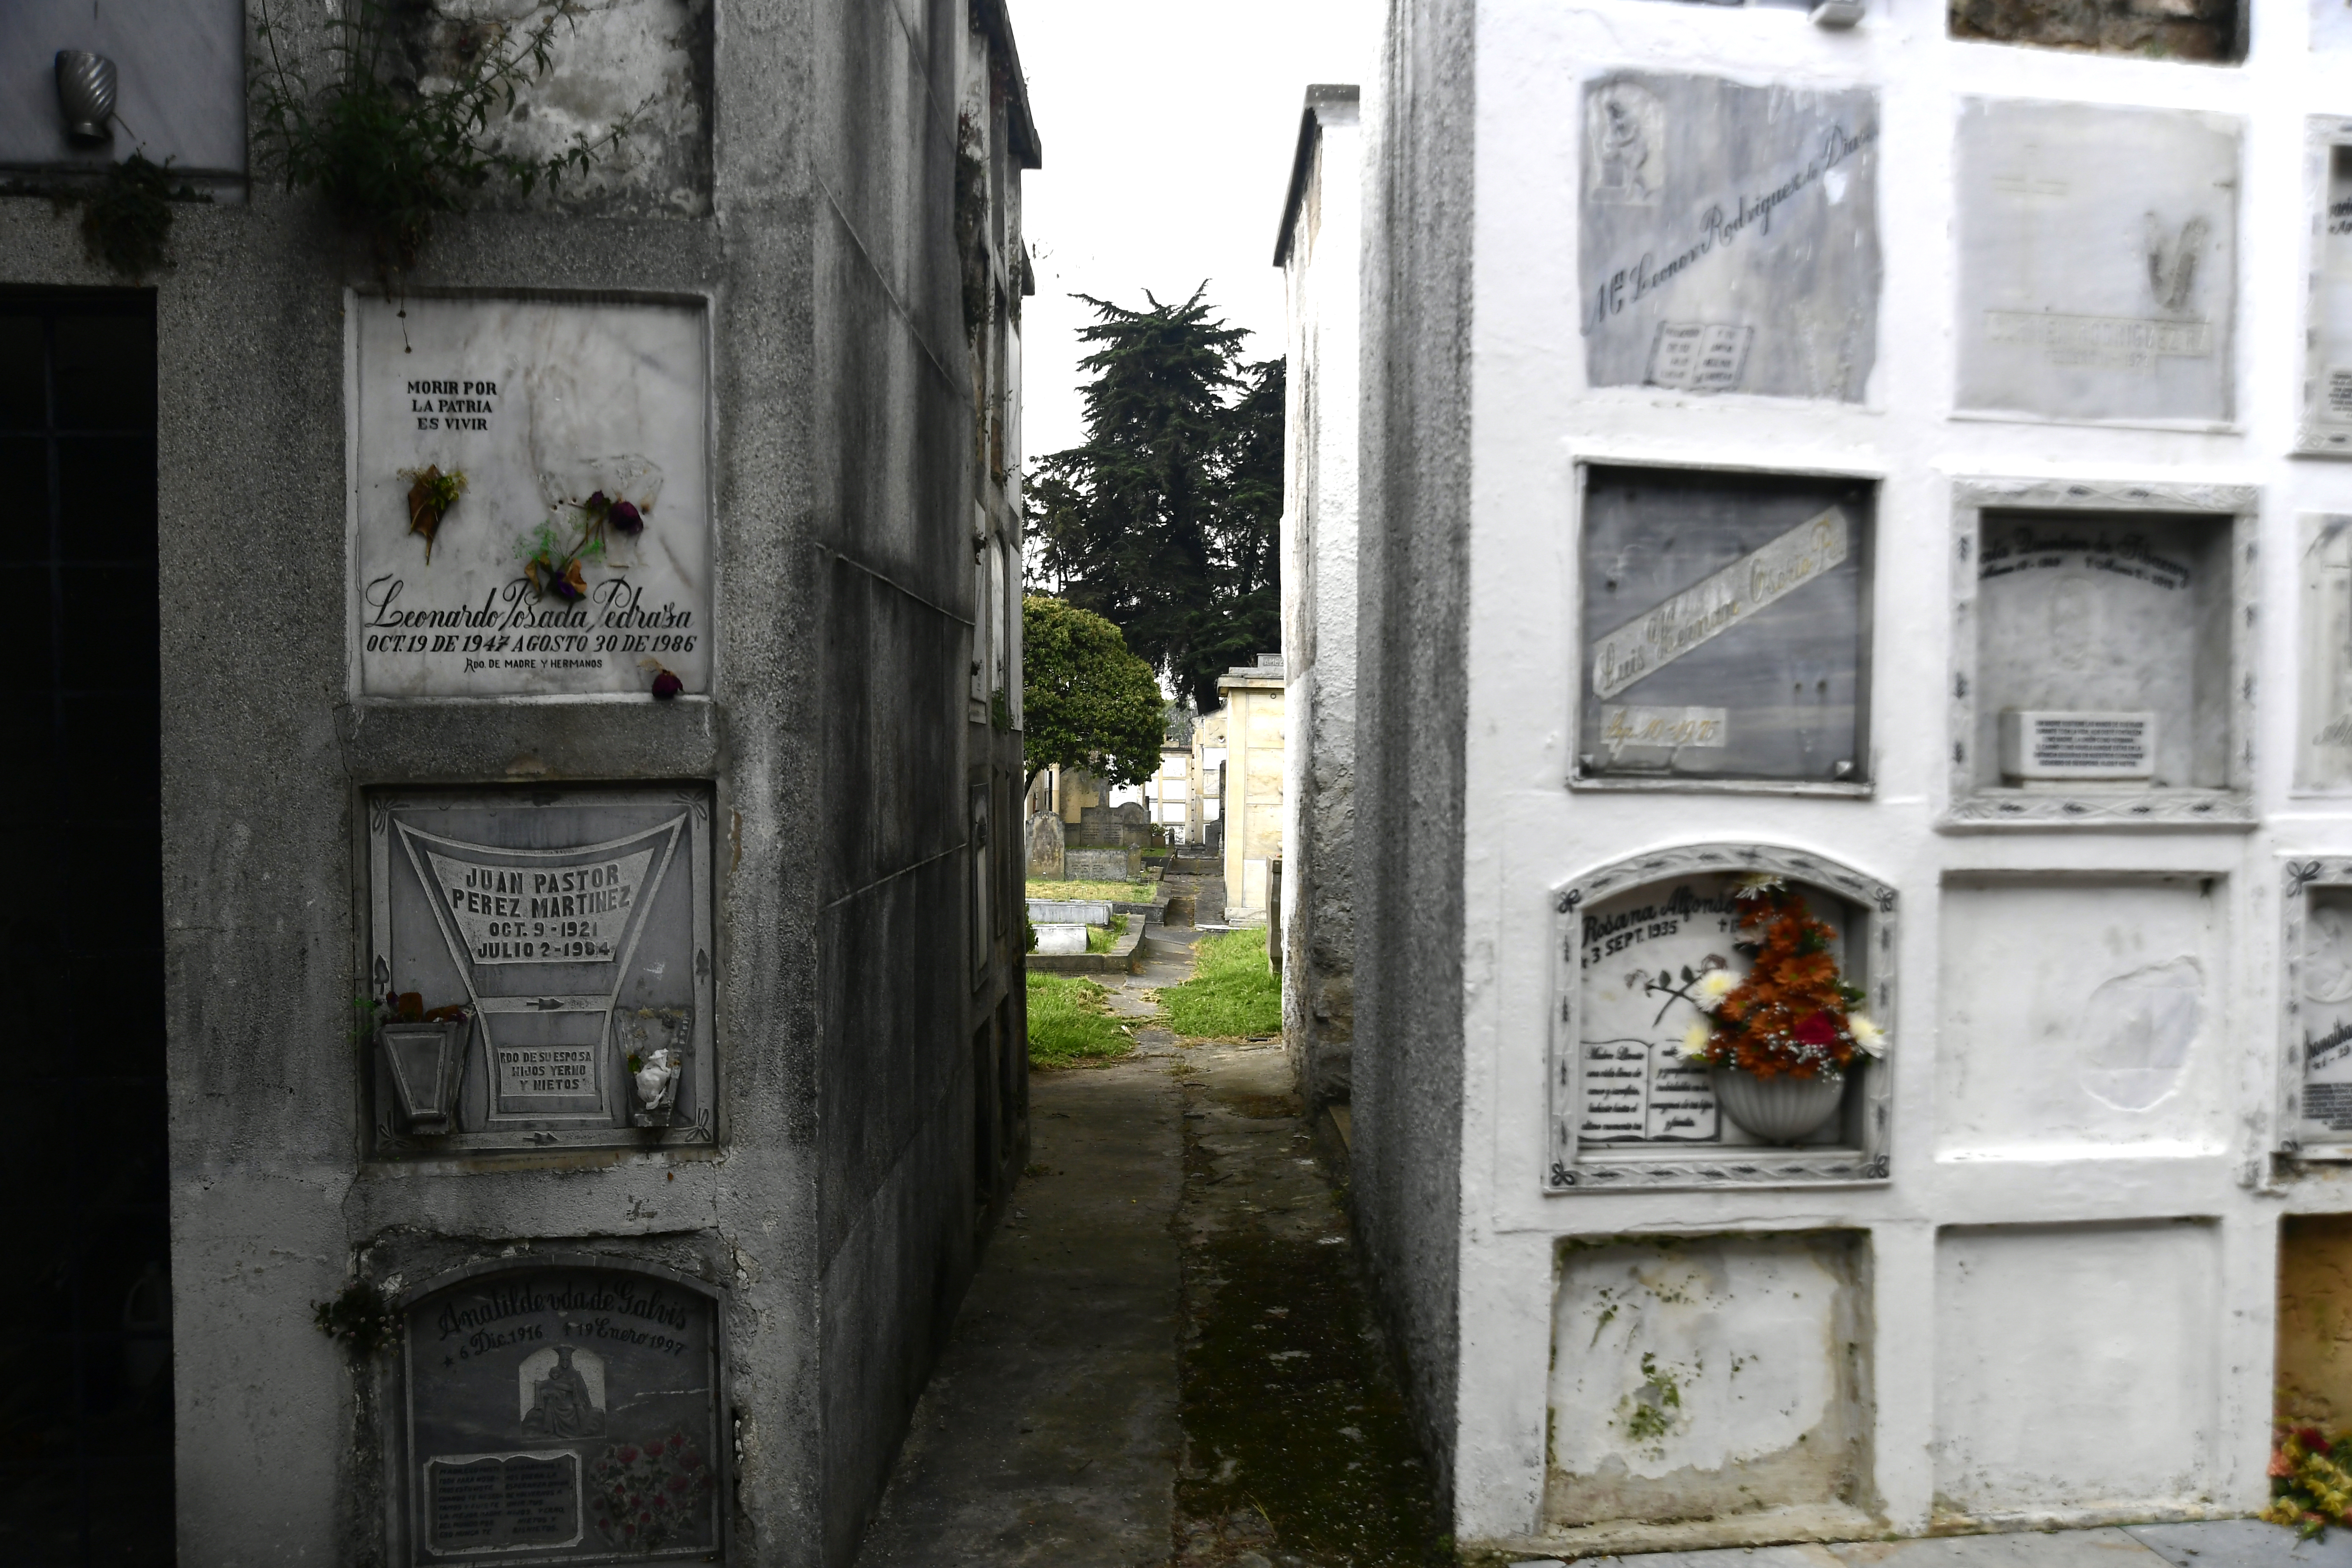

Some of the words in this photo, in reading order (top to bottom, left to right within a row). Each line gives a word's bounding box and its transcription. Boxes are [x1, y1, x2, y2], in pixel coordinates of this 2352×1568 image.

[407, 381, 459, 395] MORIR
[463, 381, 497, 395] POR
[412, 400, 433, 412] LA
[438, 400, 493, 413] PATRIA
[417, 417, 439, 430] ES
[444, 418, 488, 430] VIVIR
[365, 573, 505, 629] Leonardo
[498, 577, 590, 631] Posada
[430, 635, 459, 652] DE
[511, 635, 588, 653] AGOSTO
[593, 635, 617, 652] 30
[621, 635, 649, 652] DE
[651, 635, 697, 652] 1986
[489, 660, 500, 668] DE
[504, 660, 536, 668] MADRE
[541, 659, 548, 668] Y
[550, 660, 602, 668] HERMANOS
[466, 867, 523, 894] JUAN
[534, 864, 619, 893] PASTOR
[452, 888, 521, 917] PEREZ
[531, 885, 630, 918] MARTINEZ
[478, 942, 534, 958] JULIO
[500, 1052, 519, 1063] RDO
[523, 1052, 537, 1062] DE
[539, 1052, 551, 1062] SU
[554, 1051, 592, 1062] ESPOSA
[512, 1066, 545, 1076] HIJOS
[550, 1065, 586, 1075] YERNO
[520, 1080, 528, 1091] Y
[534, 1079, 580, 1090] NIETOS
[509, 1324, 543, 1343] 1916
[595, 1318, 649, 1345] Enero
[650, 1335, 686, 1357] 1997
